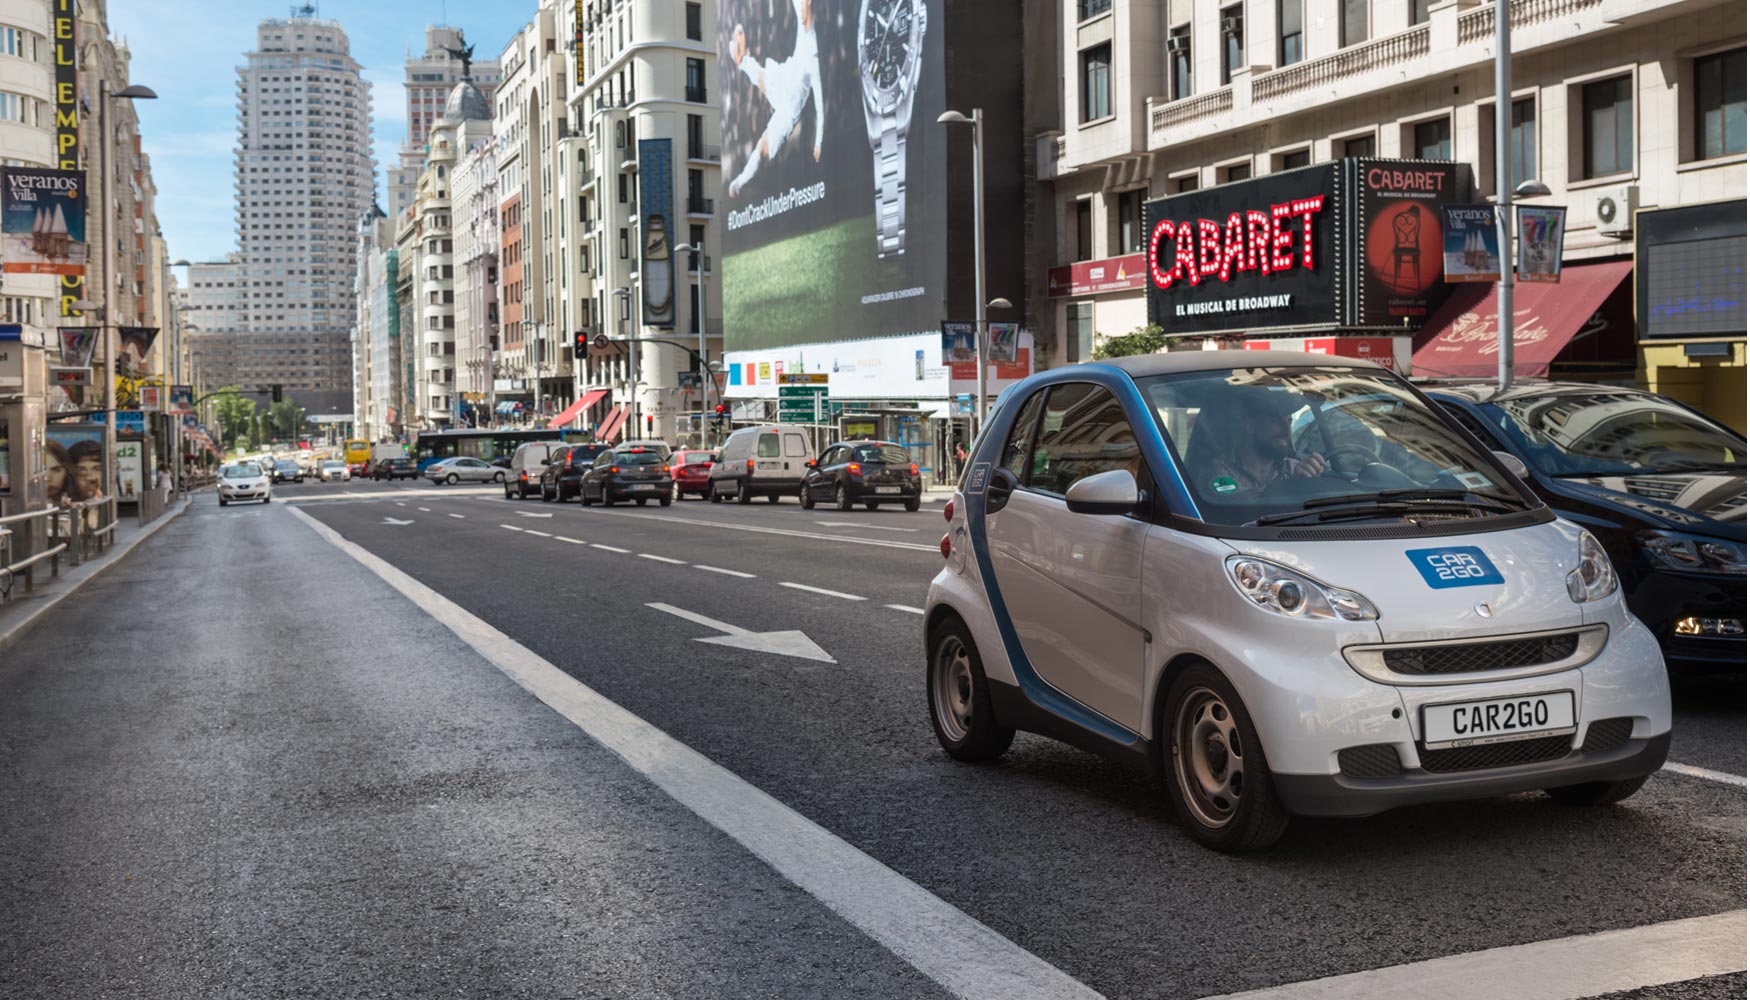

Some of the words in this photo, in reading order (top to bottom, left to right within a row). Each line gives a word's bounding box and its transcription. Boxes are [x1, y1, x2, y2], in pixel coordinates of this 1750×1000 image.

[8, 174, 78, 191] veranos
[1368, 168, 1445, 190] CABARET
[13, 188, 38, 201] villa
[728, 181, 825, 230] #DontCrackUnderPressure
[1448, 209, 1490, 220] veranos
[1450, 220, 1466, 229] villa
[1151, 195, 1324, 289] CABARET
[1176, 305, 1186, 316] EL
[1187, 301, 1224, 314] MUSICAL
[1226, 300, 1237, 312] DE
[1238, 294, 1290, 309] BROADWAY
[1426, 553, 1475, 567] CAR
[1435, 564, 1484, 580] 2GO
[1453, 699, 1548, 734] CAR2GO
